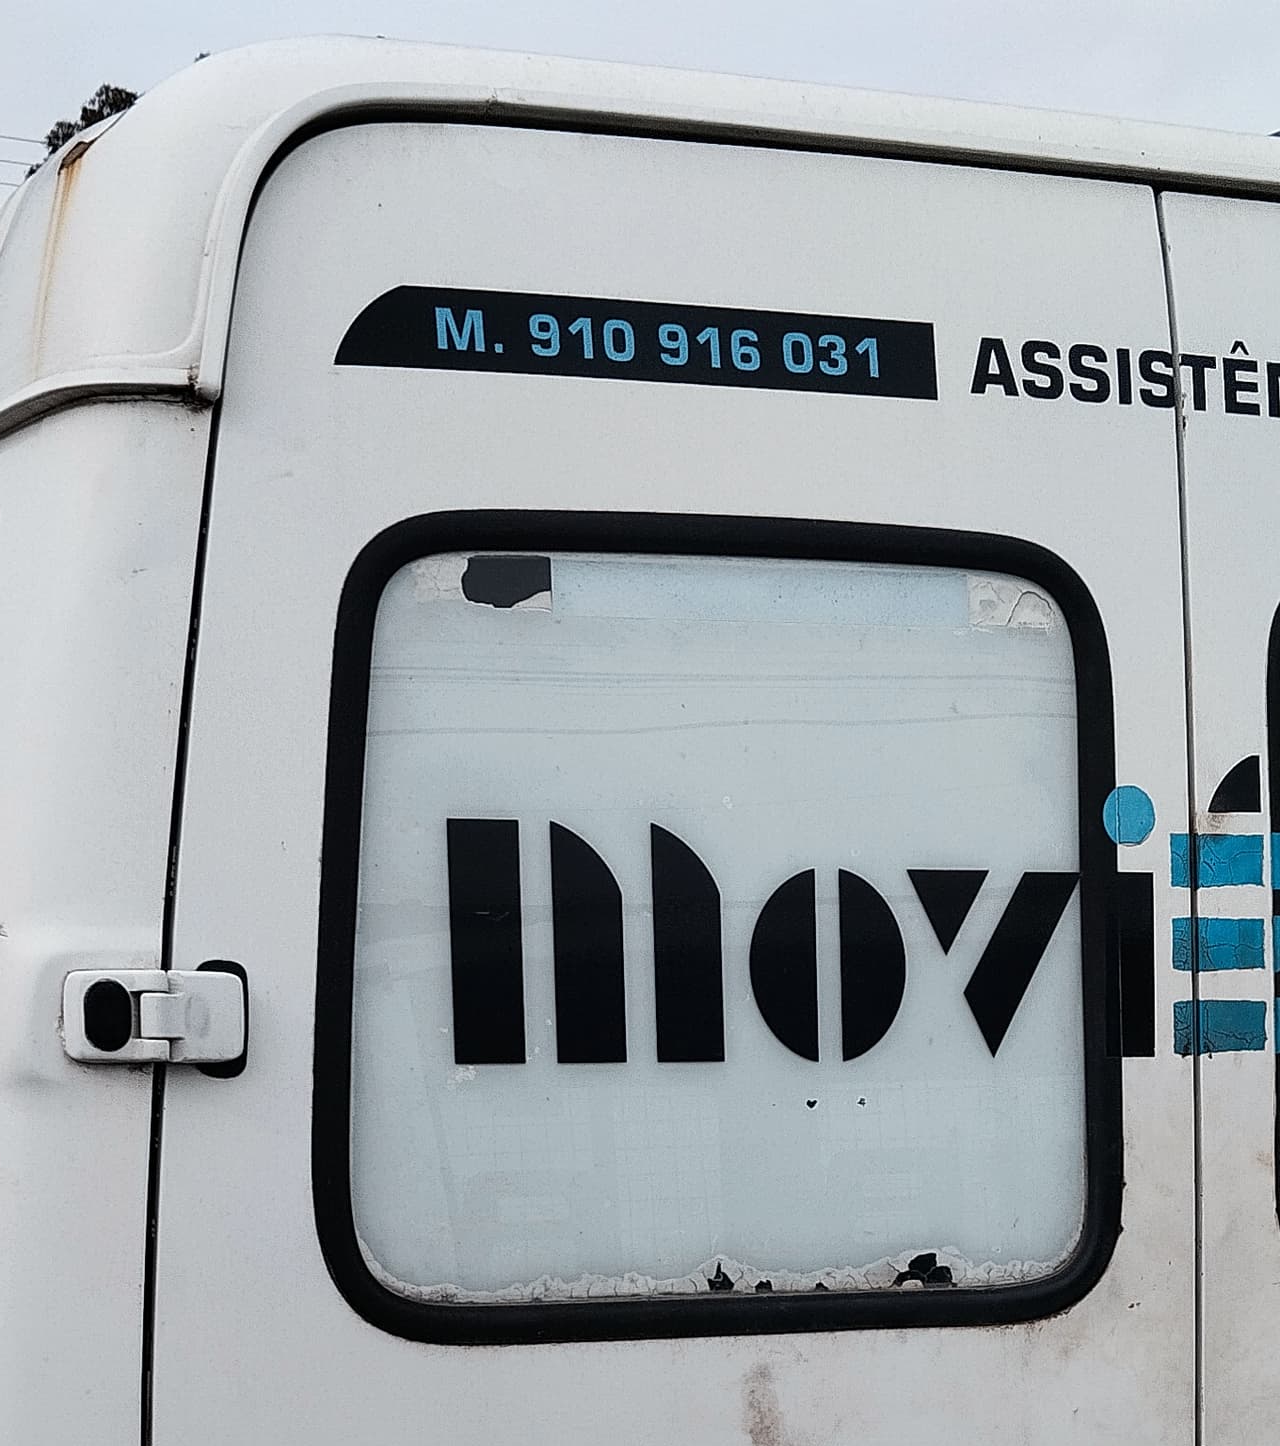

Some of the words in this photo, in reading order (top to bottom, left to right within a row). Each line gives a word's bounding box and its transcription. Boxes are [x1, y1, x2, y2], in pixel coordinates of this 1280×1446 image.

[434, 305, 504, 354] M.
[528, 313, 636, 362] 910
[657, 322, 762, 372] 916
[781, 331, 880, 379] 031
